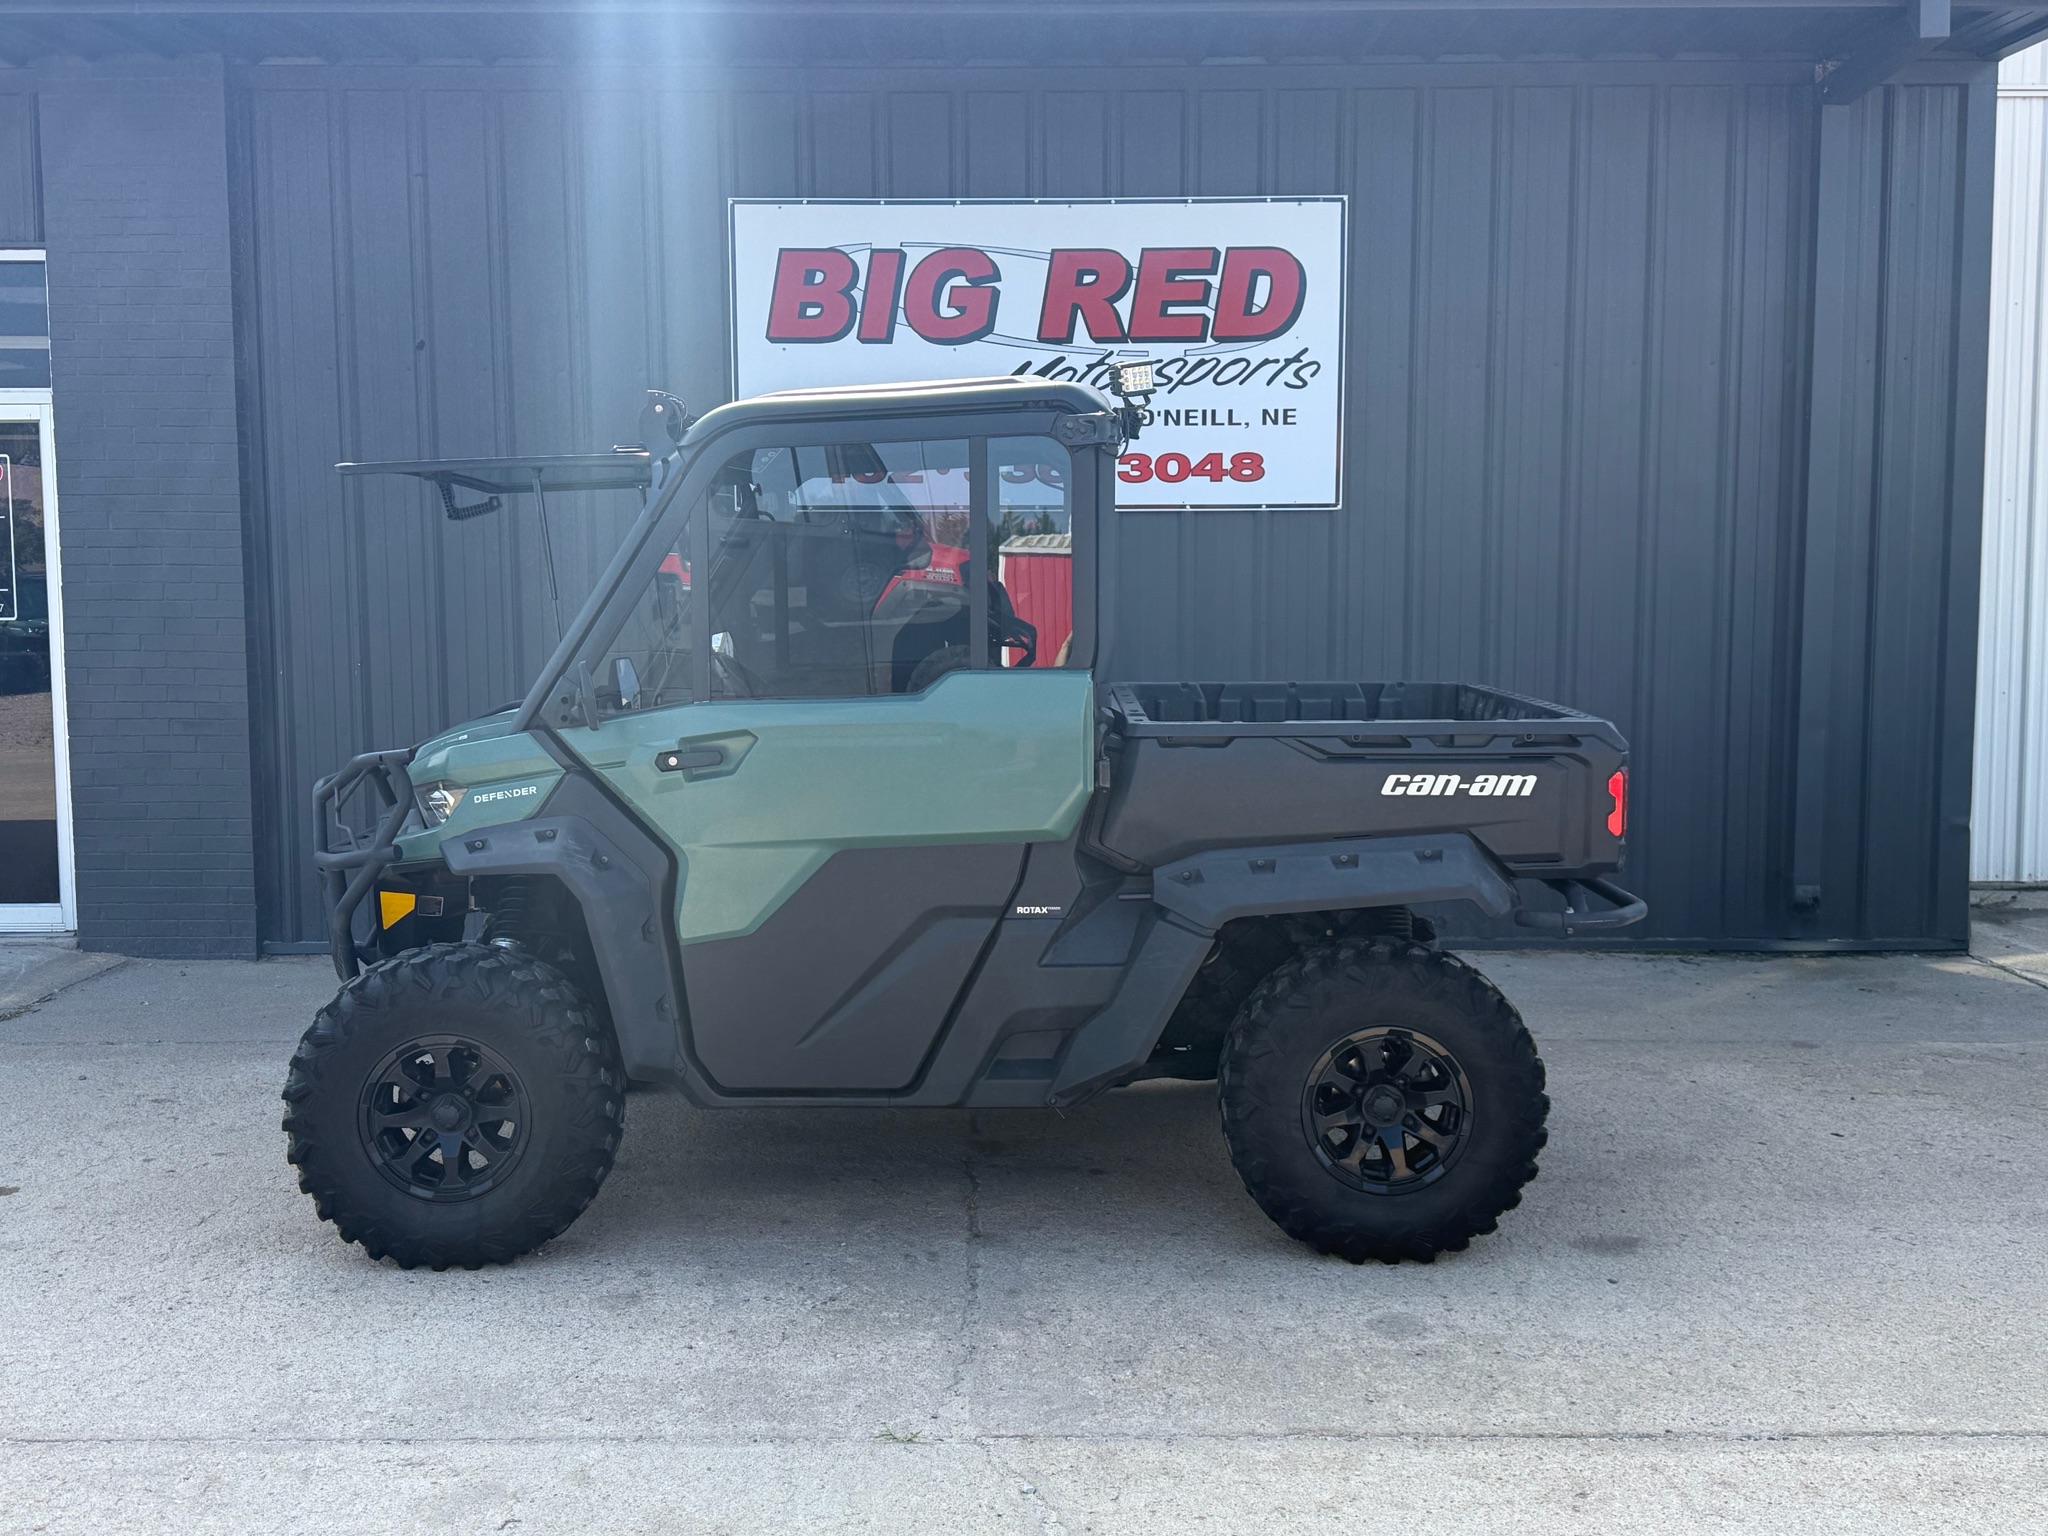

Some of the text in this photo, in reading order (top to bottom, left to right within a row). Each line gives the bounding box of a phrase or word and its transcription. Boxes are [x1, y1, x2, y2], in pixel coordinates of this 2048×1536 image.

[765, 246, 1307, 345] BIG RED
[1010, 347, 1321, 395] otosports
[1261, 408, 1297, 426] NE
[1117, 451, 1265, 483] 3048
[473, 786, 537, 804] DEFENDER
[1380, 774, 1538, 796] can-am
[1016, 906, 1048, 914] ROTAX
